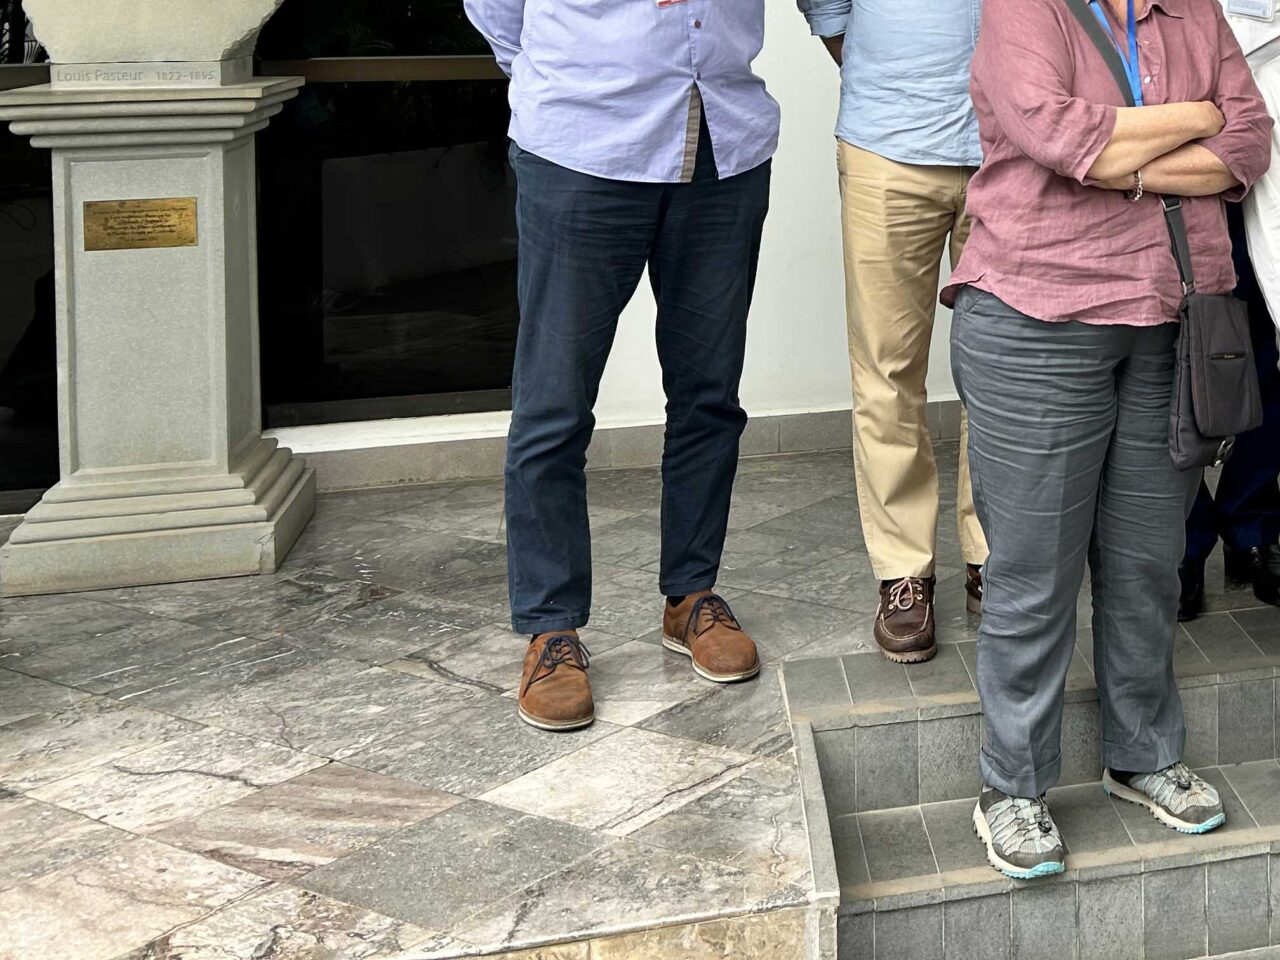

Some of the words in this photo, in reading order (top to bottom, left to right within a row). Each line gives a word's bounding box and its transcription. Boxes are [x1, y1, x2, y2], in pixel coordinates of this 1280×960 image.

[57, 69, 91, 81] Louis
[95, 69, 143, 81] Pasteur
[157, 70, 214, 81] 1822-1895
